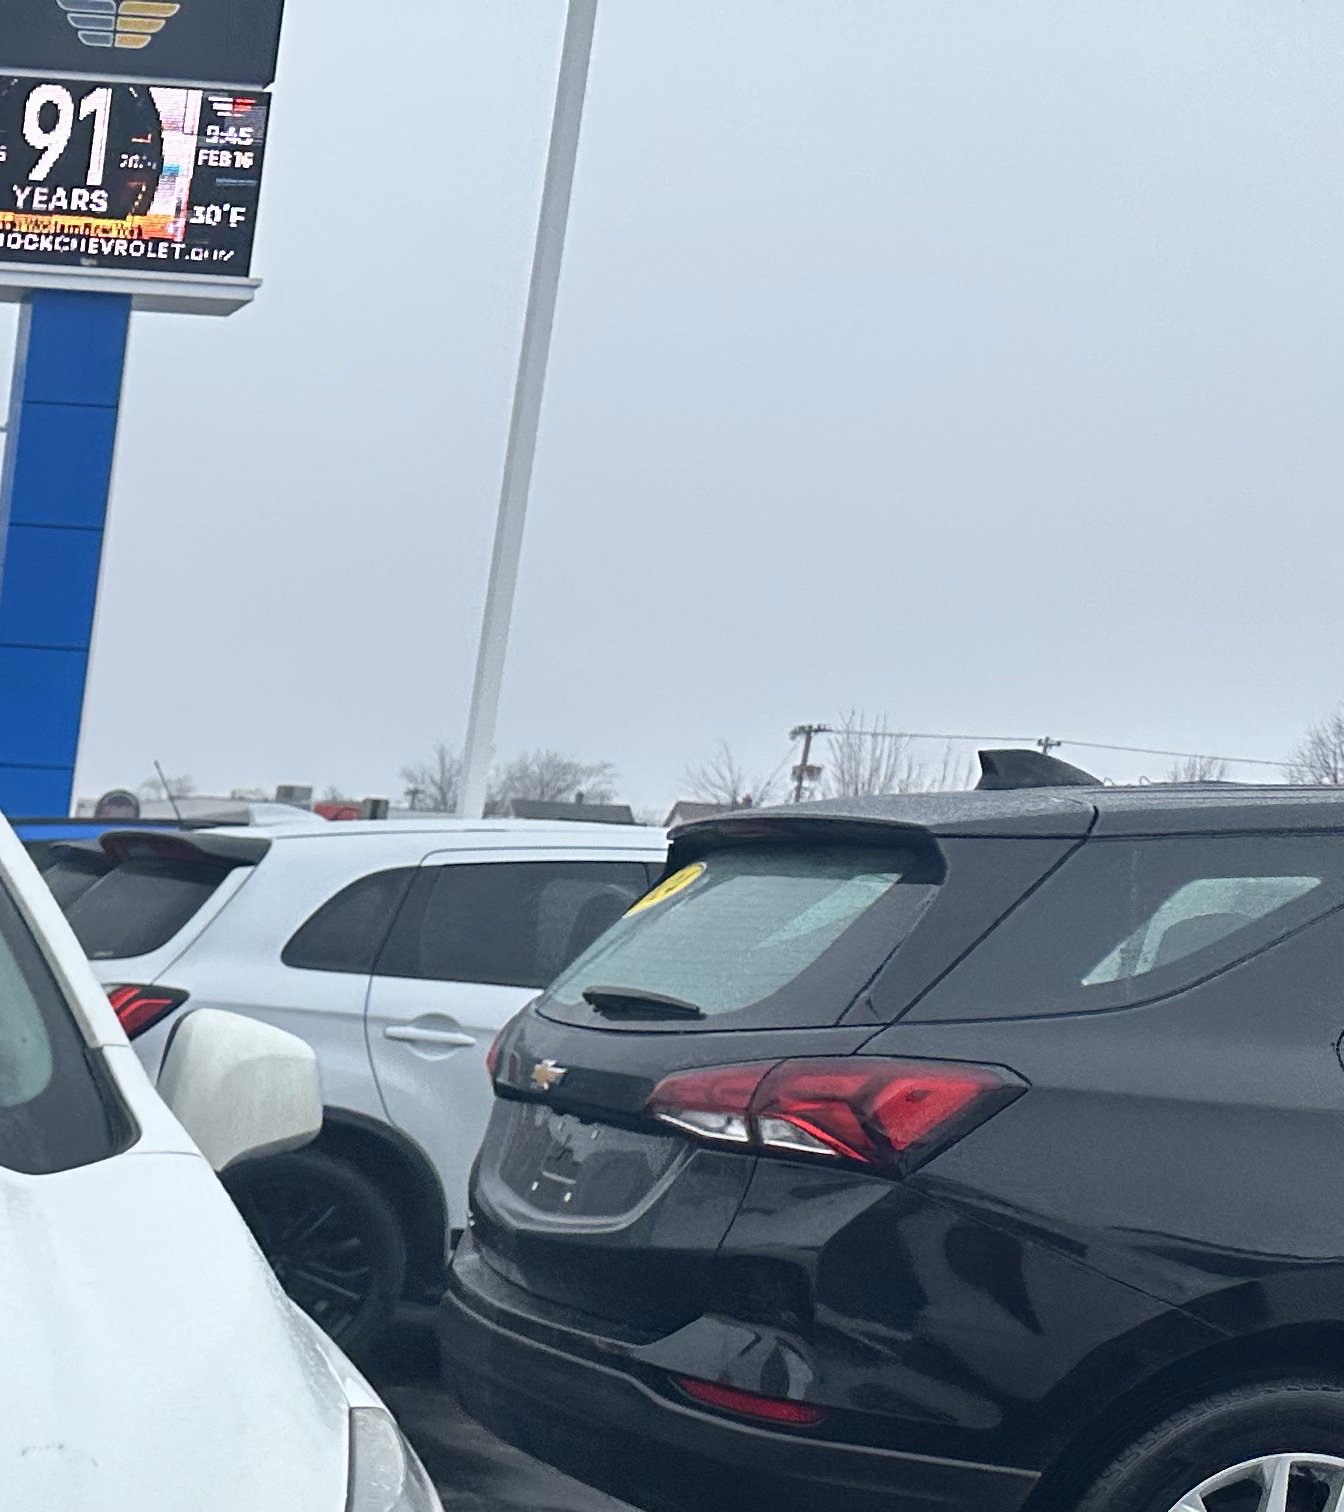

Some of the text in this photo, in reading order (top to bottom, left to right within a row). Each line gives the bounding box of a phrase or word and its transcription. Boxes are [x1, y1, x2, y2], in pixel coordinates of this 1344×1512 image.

[22, 83, 113, 187] 91
[197, 148, 233, 168] FEB
[12, 183, 110, 213] YEARS
